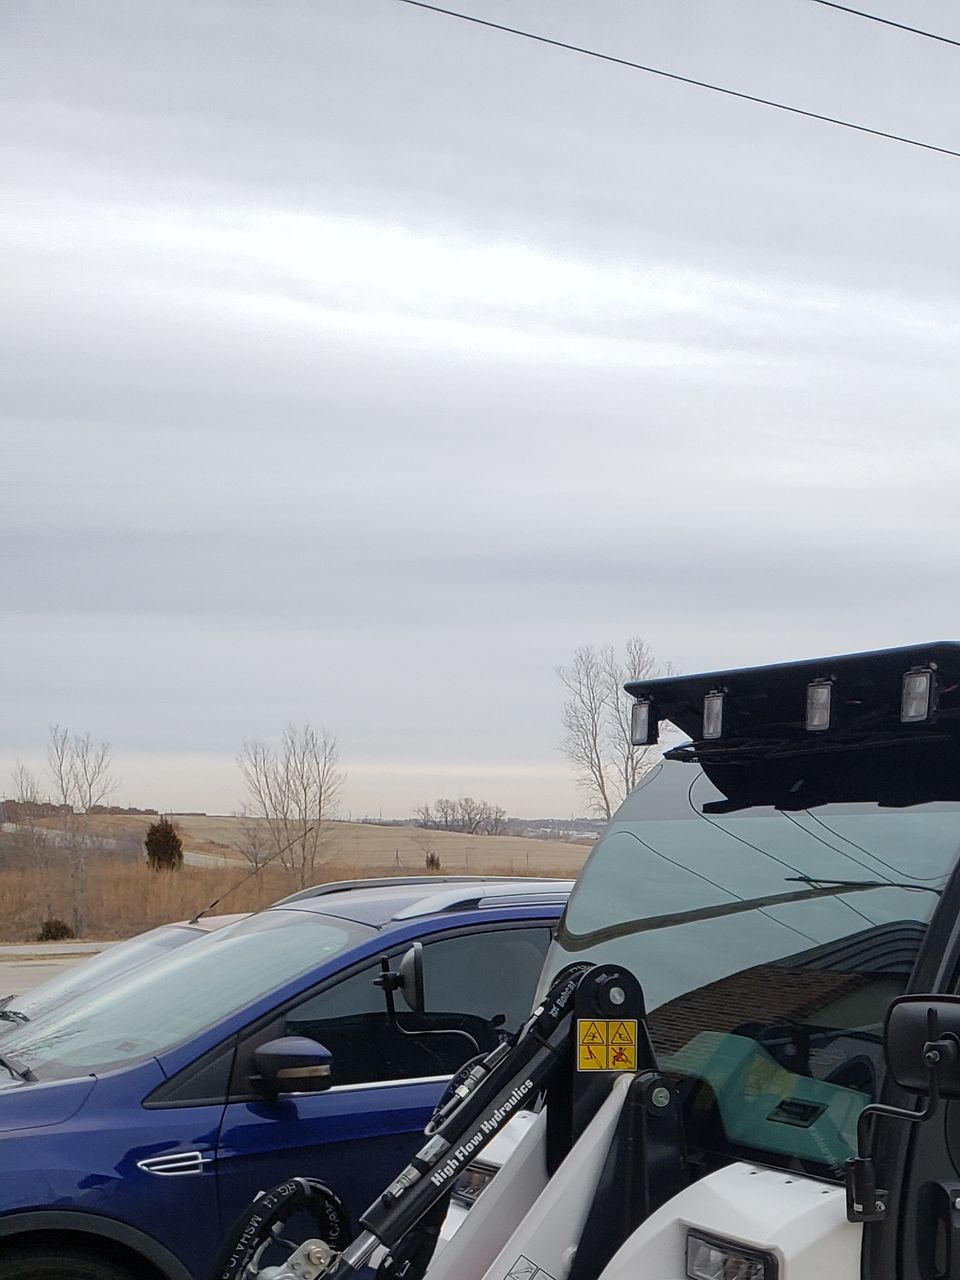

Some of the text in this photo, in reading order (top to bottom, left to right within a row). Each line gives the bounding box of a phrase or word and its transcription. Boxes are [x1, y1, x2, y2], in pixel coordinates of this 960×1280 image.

[430, 1079, 534, 1187] High Flow Hydraulics
